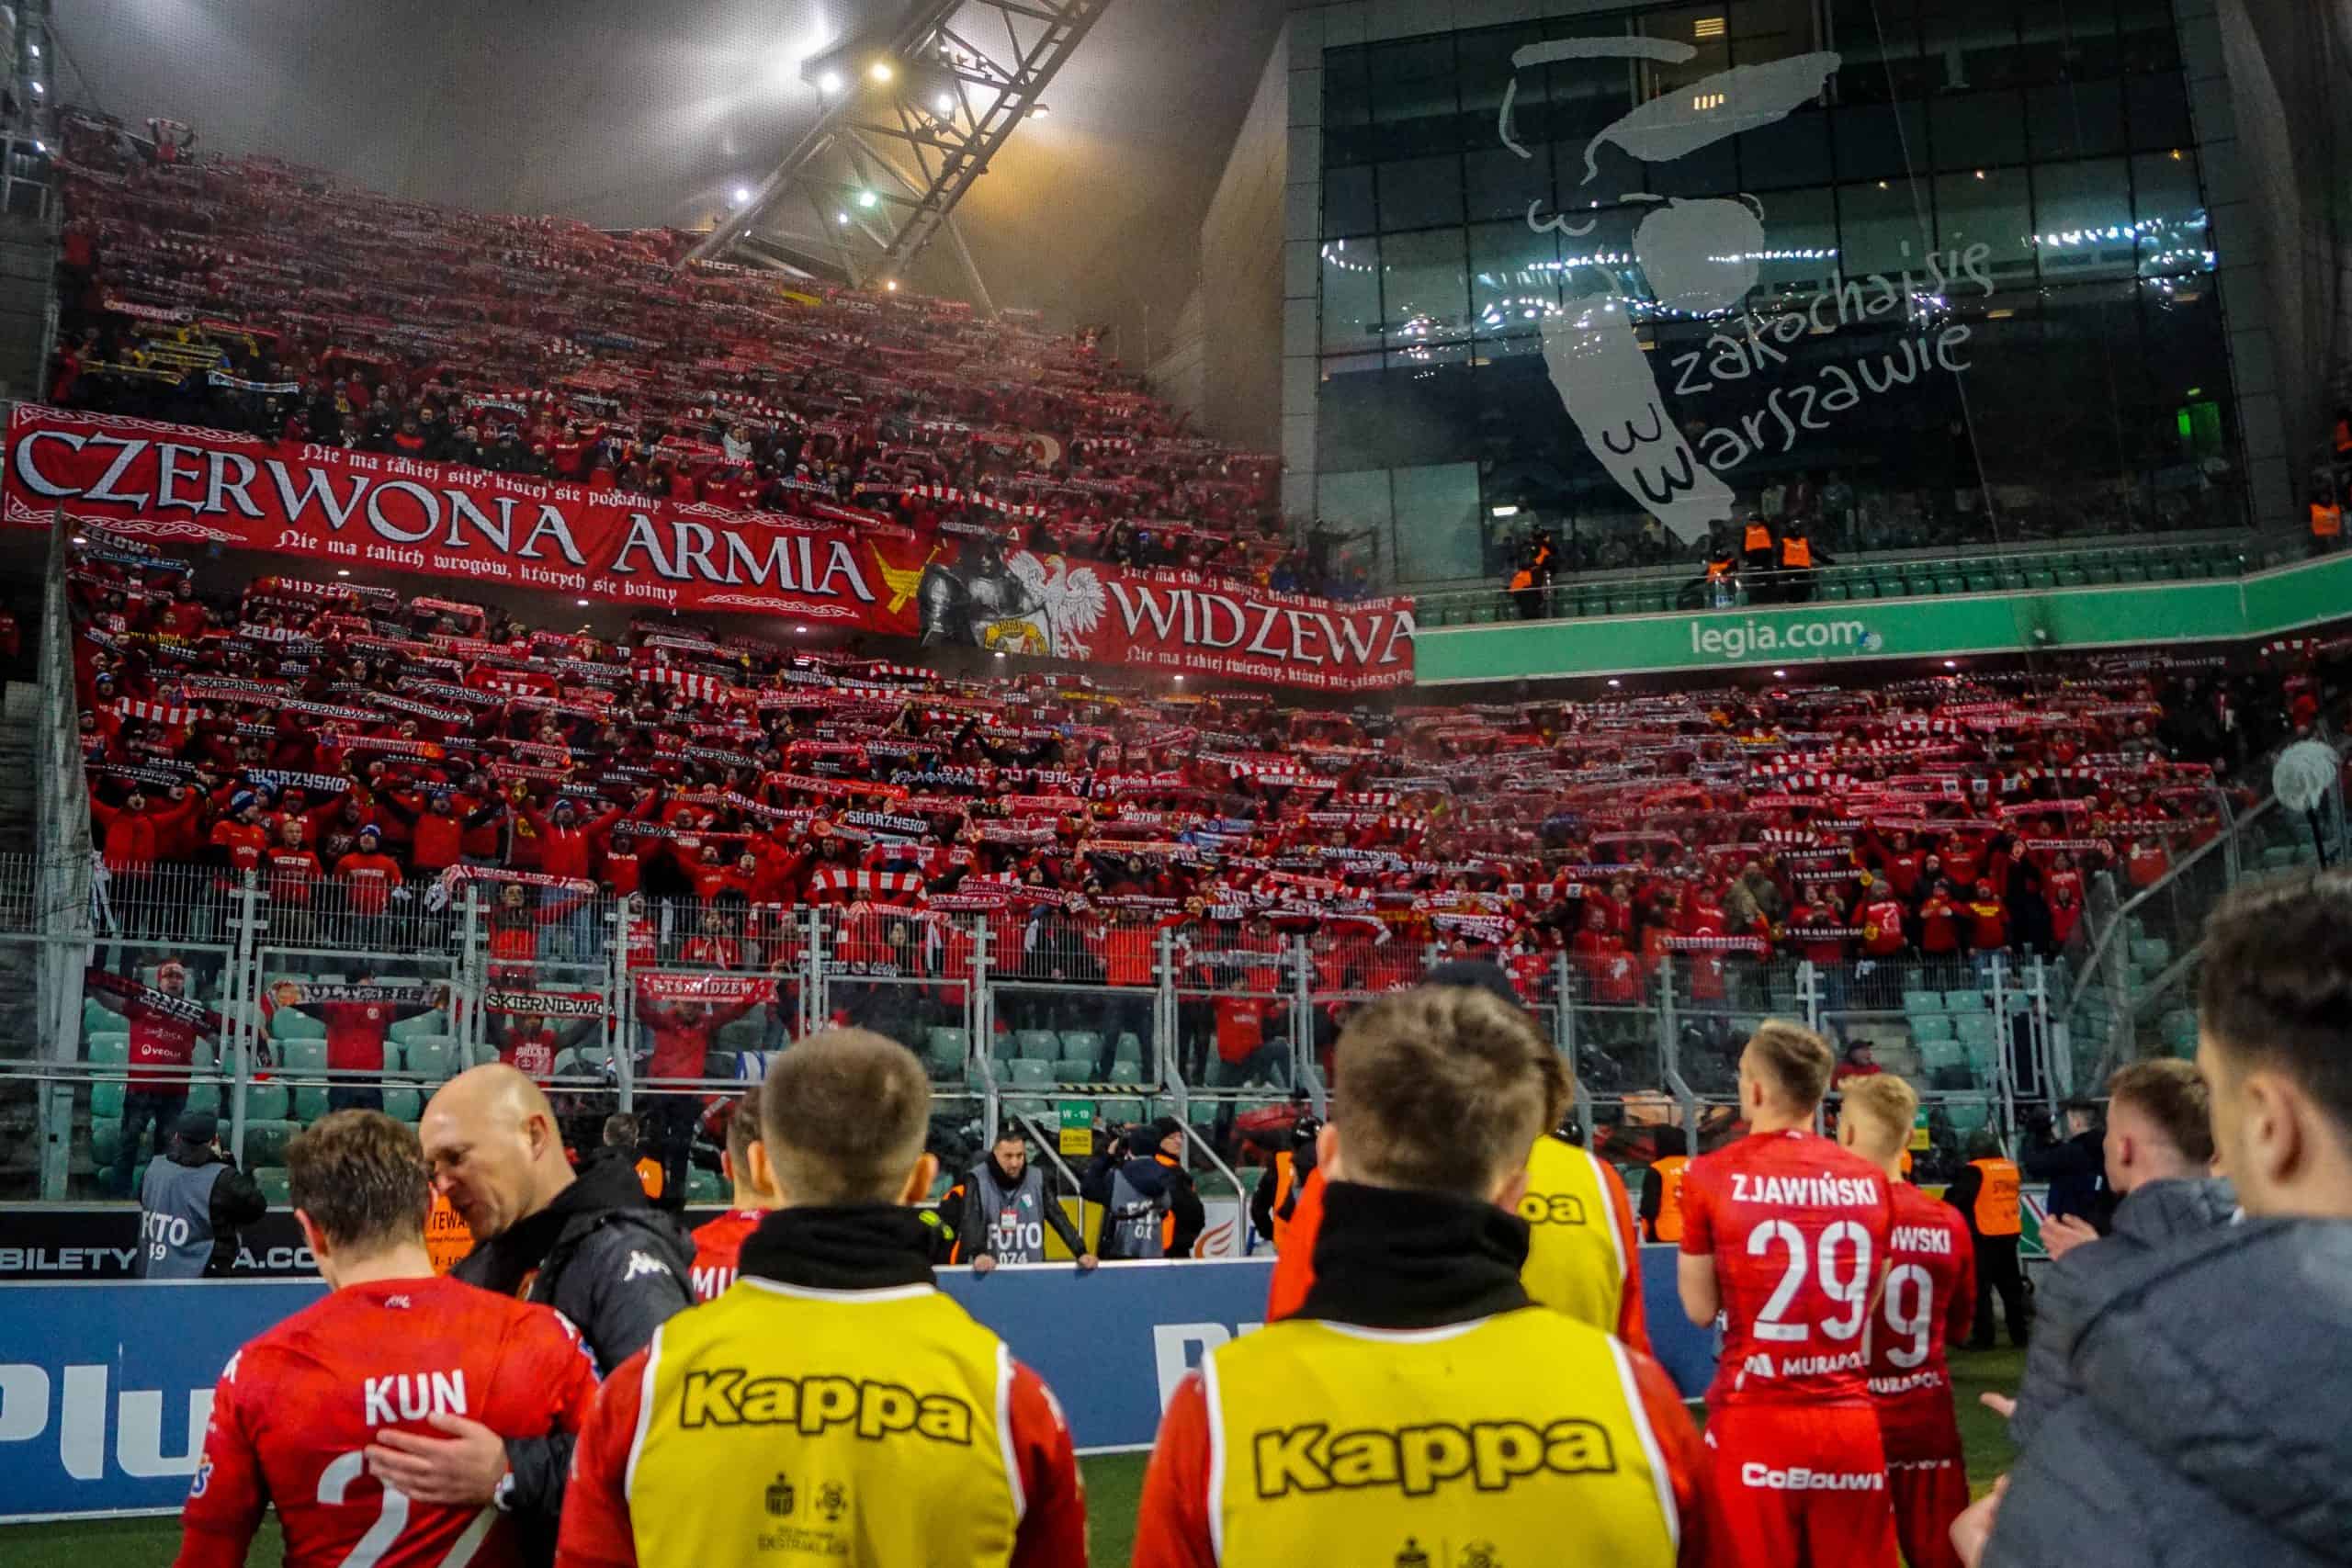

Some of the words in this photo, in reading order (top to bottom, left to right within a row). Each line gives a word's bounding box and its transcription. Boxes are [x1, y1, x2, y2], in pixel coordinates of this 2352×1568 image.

[1670, 240, 1916, 396] zakochaj
[300, 443, 341, 463] Nie
[349, 452, 379, 470] ma
[16, 429, 585, 567] CZERWONA
[612, 513, 876, 602] ARMIA
[275, 529, 318, 549] Nie
[327, 538, 357, 557] ma
[367, 544, 424, 568] takich
[625, 580, 677, 606] boimy
[1107, 581, 1415, 663] WIDZEWA
[1690, 619, 1864, 659] legia.com
[1731, 1171, 1878, 1206] ZJAWIŃSKI
[1747, 1218, 1872, 1341] 29
[364, 1369, 468, 1427] KUN
[680, 1367, 973, 1447] Kappa
[1252, 1418, 1618, 1500] Kappa
